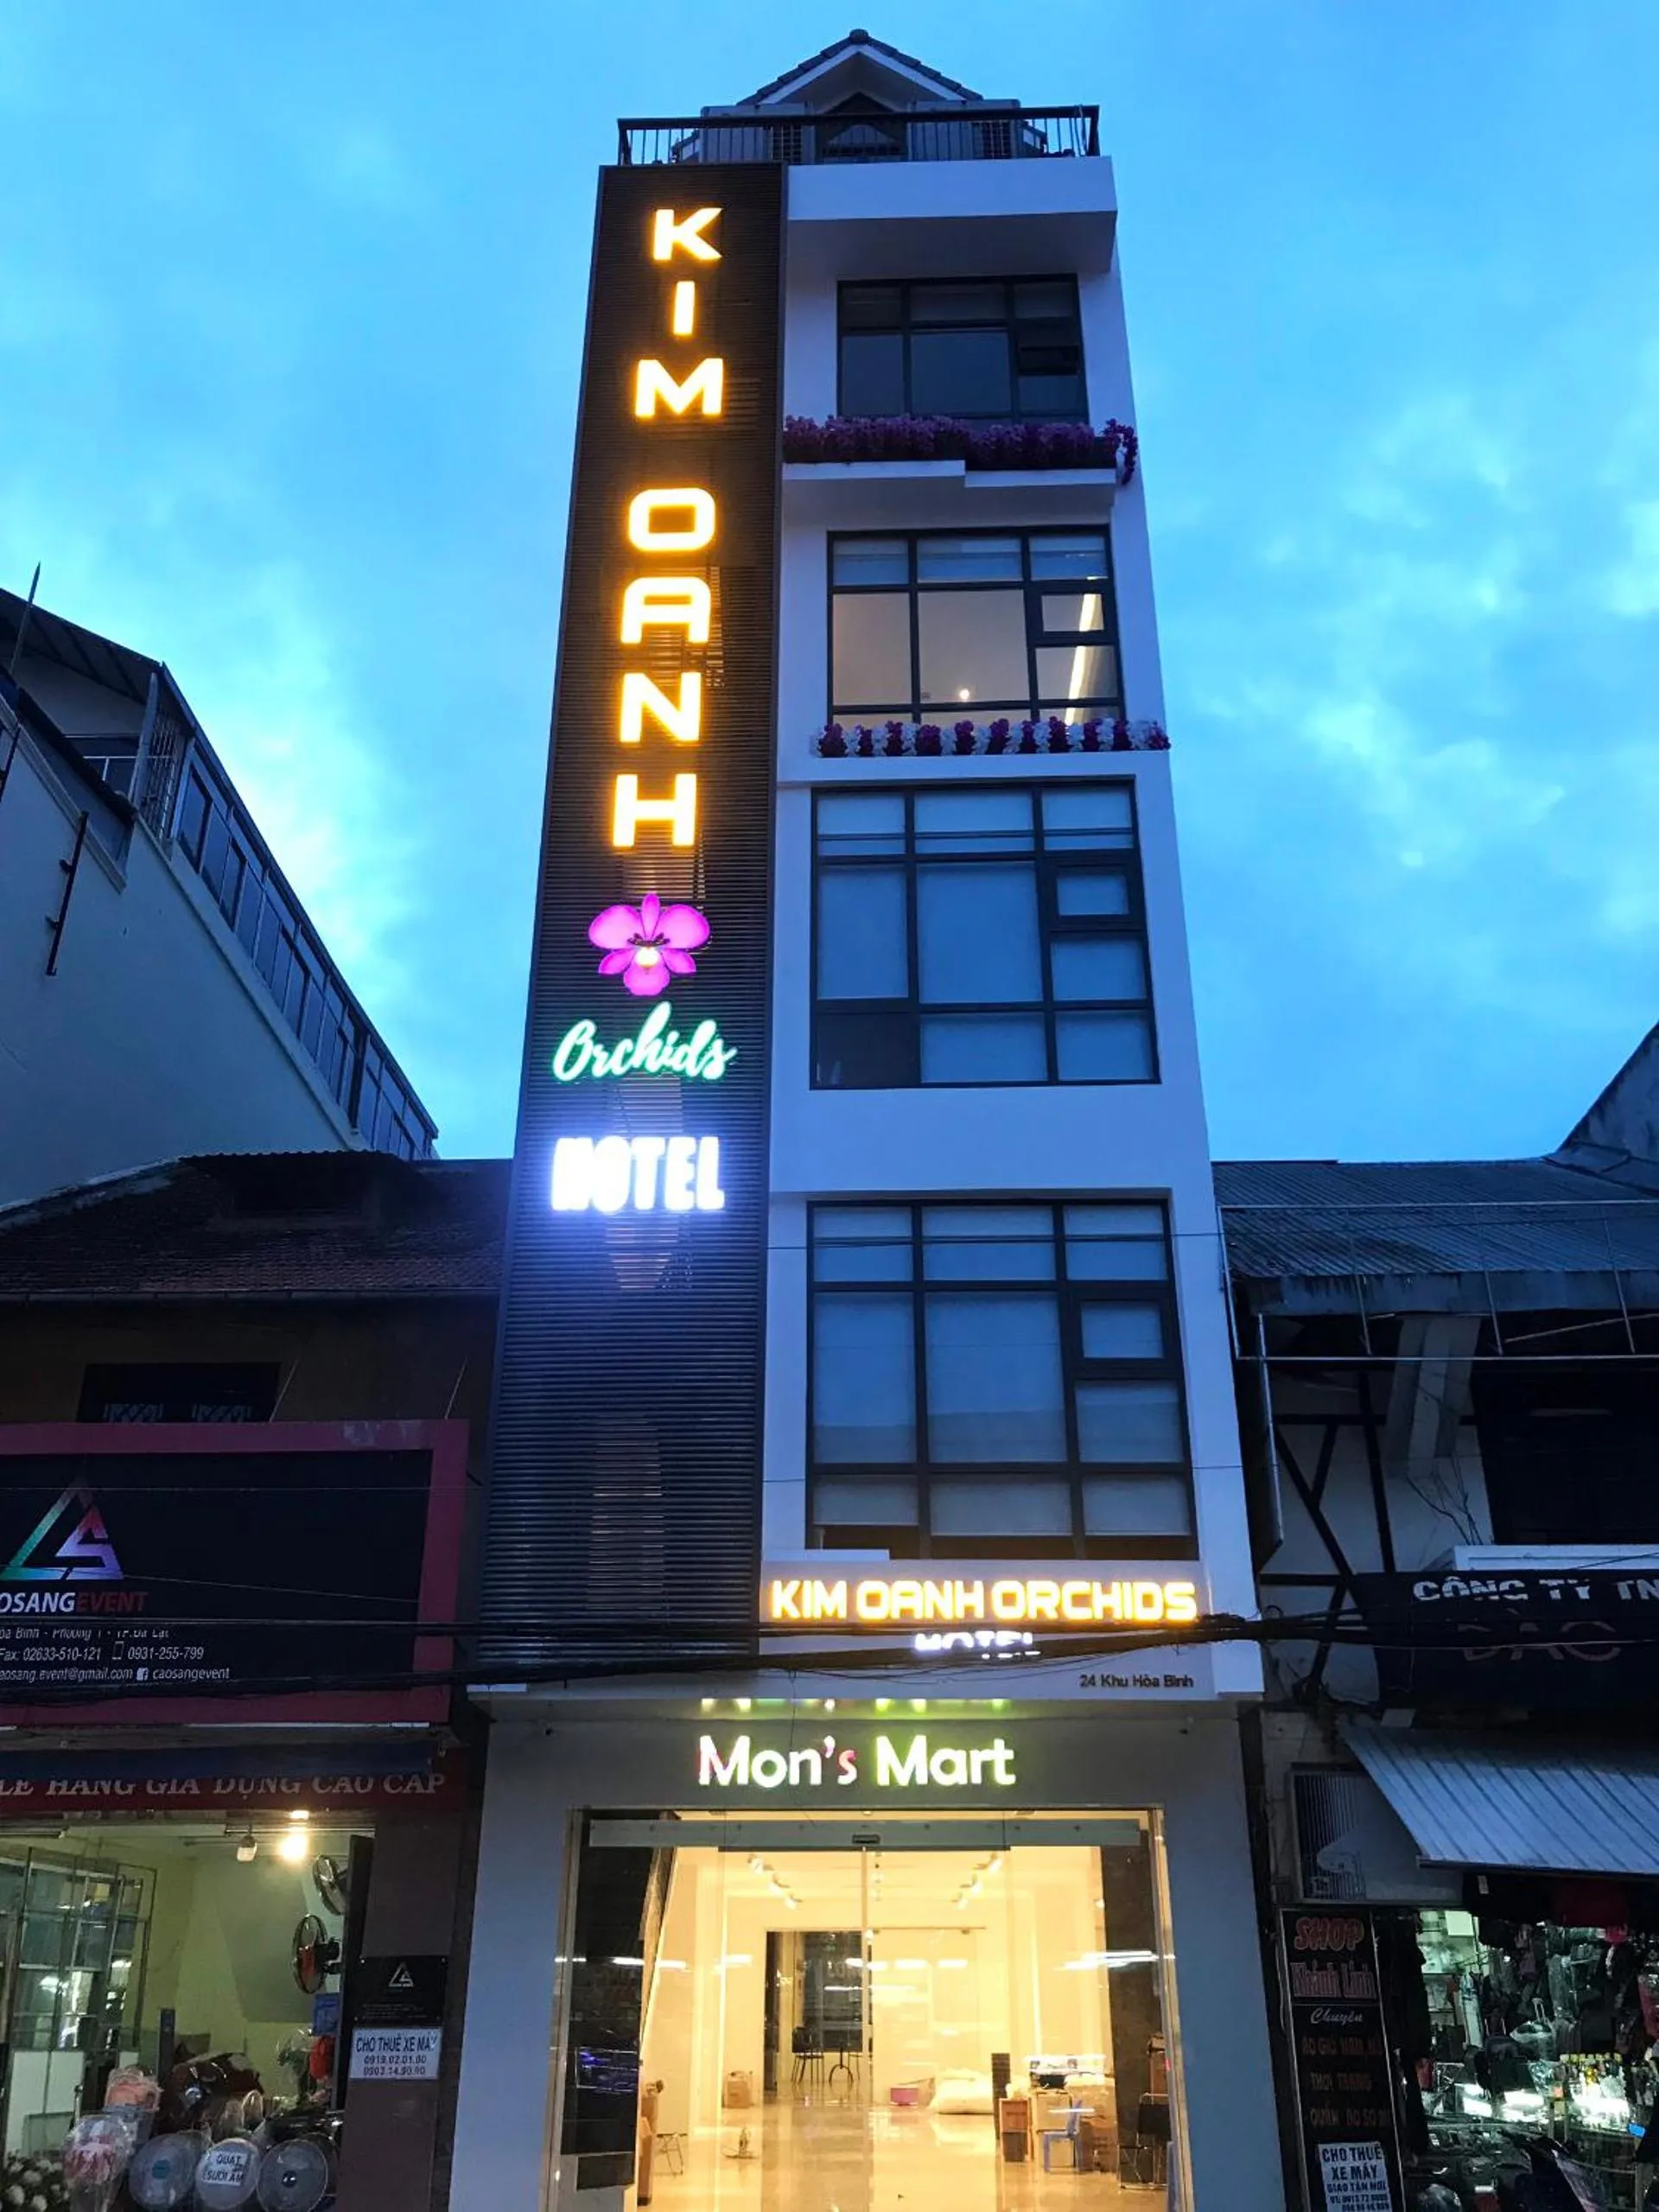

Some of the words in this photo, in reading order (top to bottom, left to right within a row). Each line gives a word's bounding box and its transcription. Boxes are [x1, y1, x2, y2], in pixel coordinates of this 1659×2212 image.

[633, 207, 724, 420] KIM
[611, 486, 716, 848] OANH
[551, 1001, 738, 1081] Orchids
[1412, 1575, 1529, 1601] CÔNG
[1539, 1578, 1591, 1601] TY
[771, 1580, 847, 1620] KIM
[855, 1580, 985, 1621] OANH
[991, 1580, 1198, 1623] ORCHIDS
[127, 1645, 205, 1661] 0931-255-799
[152, 1667, 231, 1681] caosangevent
[1079, 1674, 1096, 1688] 24
[1101, 1674, 1128, 1688] Khu
[698, 1733, 858, 1788] Mon's
[874, 1733, 1017, 1788] Mart
[1294, 1915, 1365, 1952] SHOP
[356, 2036, 376, 2053] CHO
[402, 2036, 416, 2052] XE
[1322, 2147, 1347, 2163] CHO
[1331, 2165, 1349, 2180] XE
[1351, 2162, 1377, 2180] MÁY
